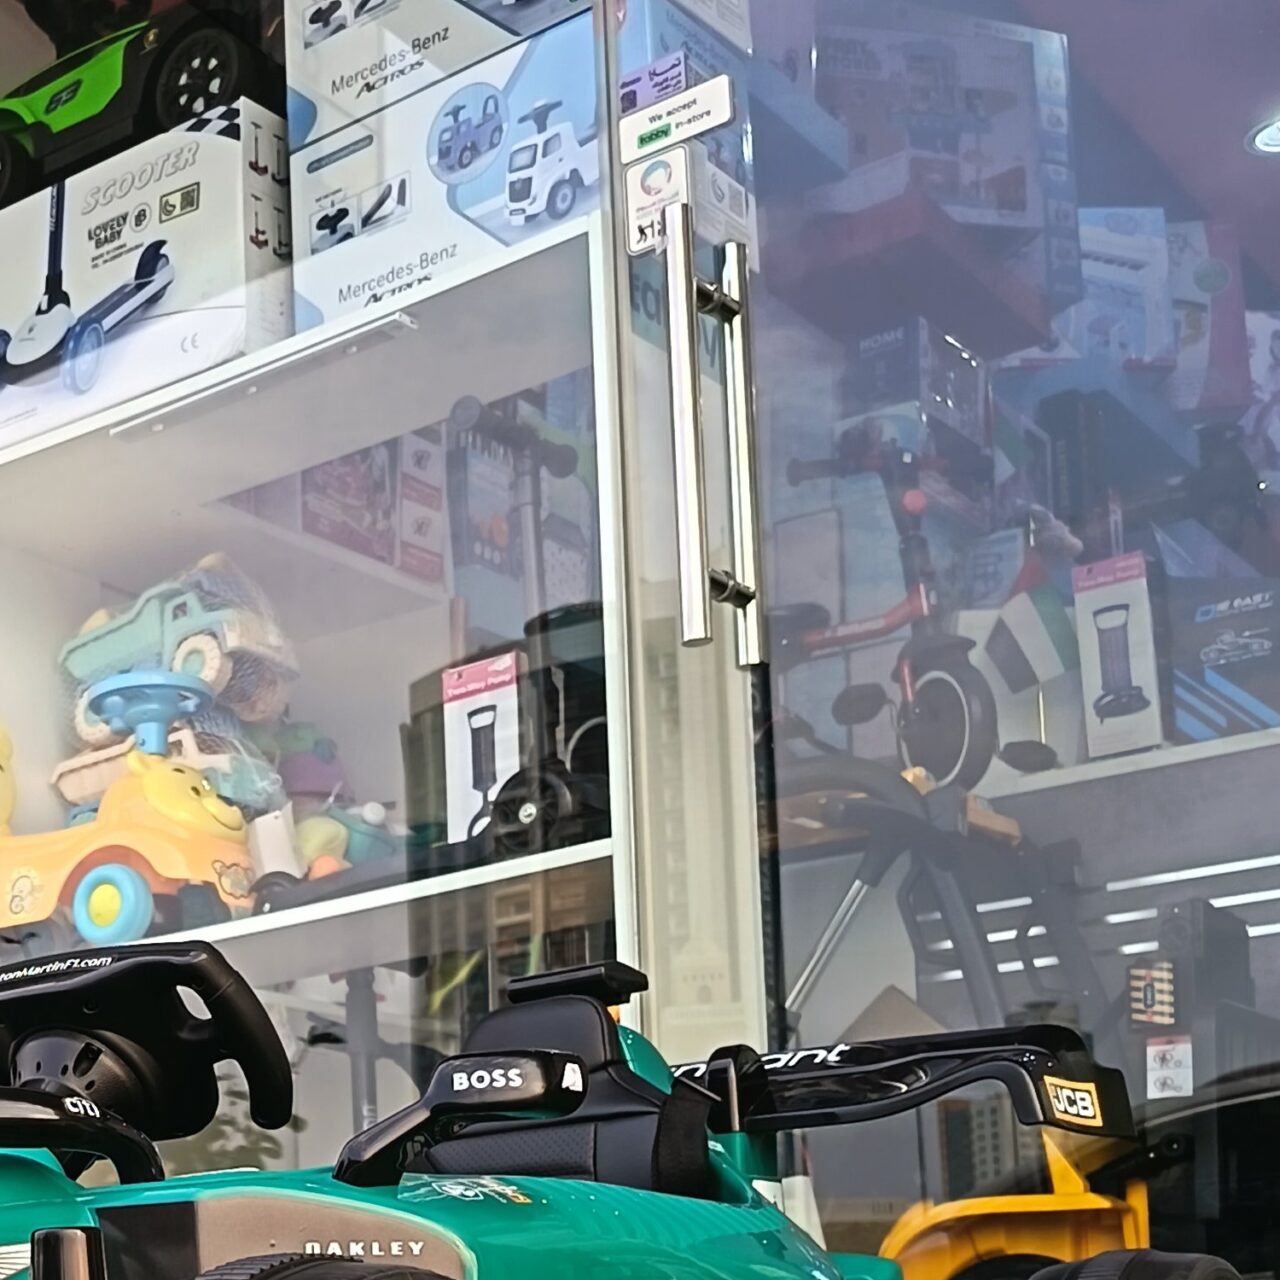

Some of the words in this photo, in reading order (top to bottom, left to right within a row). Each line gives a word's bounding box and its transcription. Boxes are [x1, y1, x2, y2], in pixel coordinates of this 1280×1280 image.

[329, 26, 450, 96] Mercedes-Benz
[81, 139, 200, 216] SCOOTER
[87, 211, 129, 241] LOVELY
[338, 243, 458, 304] Mercedes-Benz
[452, 1068, 524, 1092] BOSS
[1053, 1085, 1096, 1118] JCB
